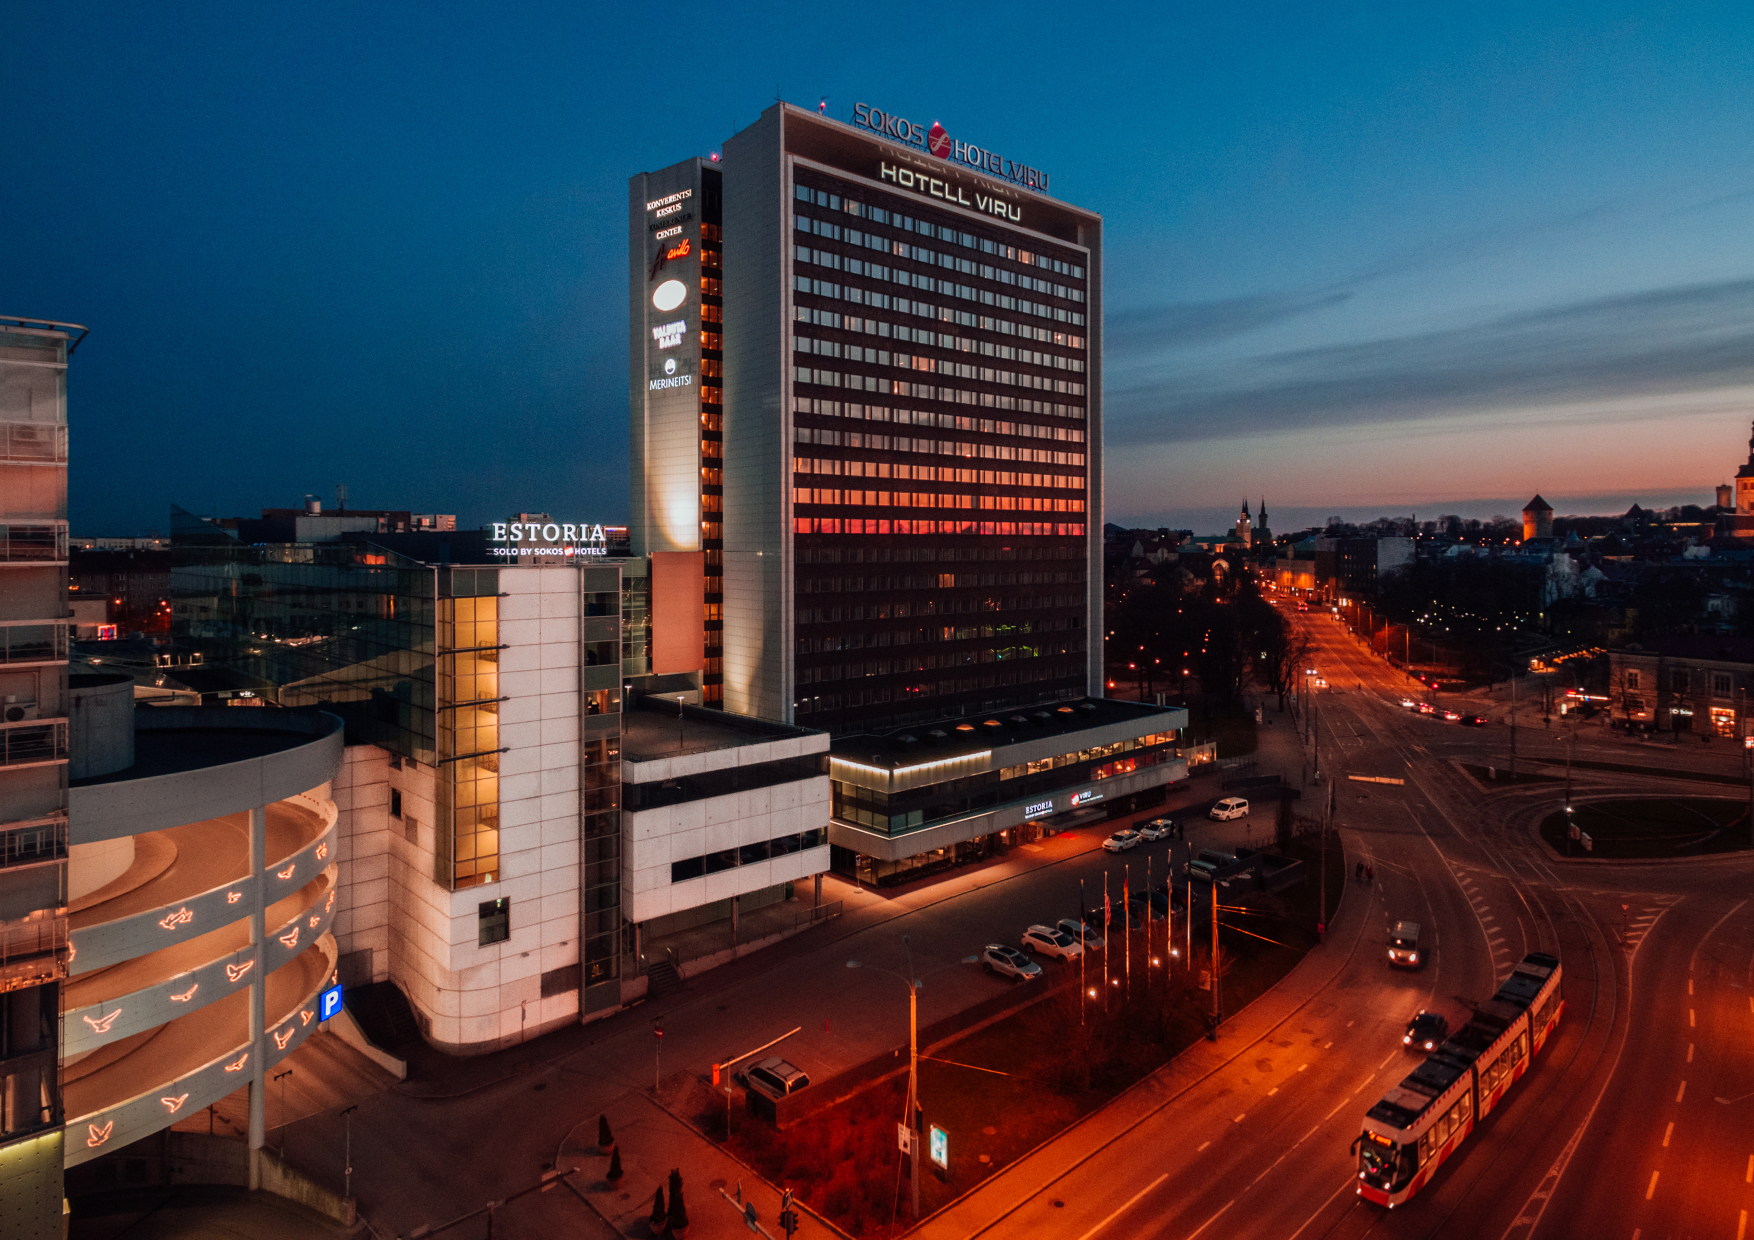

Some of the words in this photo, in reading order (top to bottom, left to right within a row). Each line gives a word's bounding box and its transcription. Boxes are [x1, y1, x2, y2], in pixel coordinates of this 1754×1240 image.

[855, 102, 924, 145] SOKOS
[955, 139, 1008, 177] HOTEL
[1010, 160, 1049, 190] VIRU
[647, 189, 692, 211] KONVERENTSI
[976, 193, 1021, 221] VIRU
[656, 203, 682, 218] KESKUS
[656, 226, 683, 240] CENTER
[649, 375, 692, 390] MERINEITSI
[492, 523, 606, 541] ESTORIA
[493, 547, 519, 556] SOLO
[520, 547, 533, 556] BY
[534, 547, 563, 556] SOKOS
[574, 547, 607, 555] HOTELS
[1025, 801, 1053, 814] ESTORIA
[325, 990, 339, 1016] P
